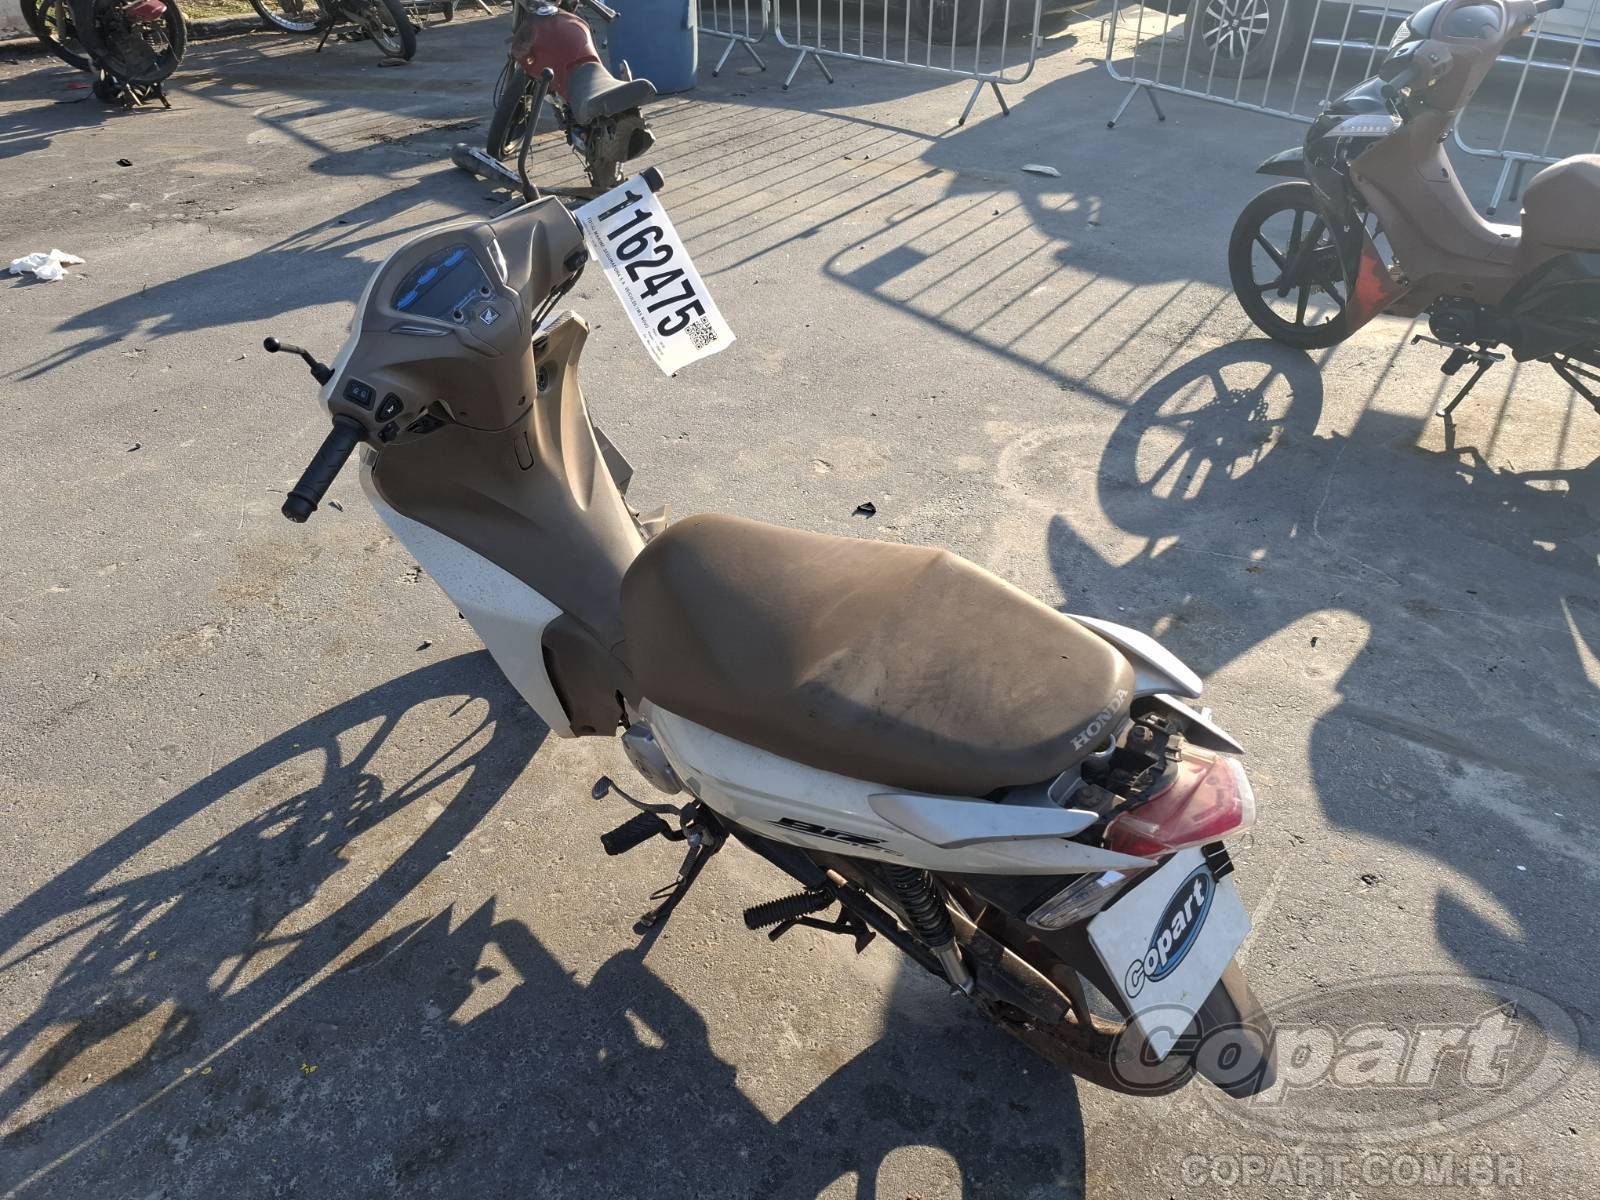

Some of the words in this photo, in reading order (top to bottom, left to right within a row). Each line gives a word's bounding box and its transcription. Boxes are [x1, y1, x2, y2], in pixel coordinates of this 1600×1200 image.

[598, 190, 706, 336] 1162475
[1070, 689, 1129, 751] HONDA
[1124, 877, 1206, 999] Copart
